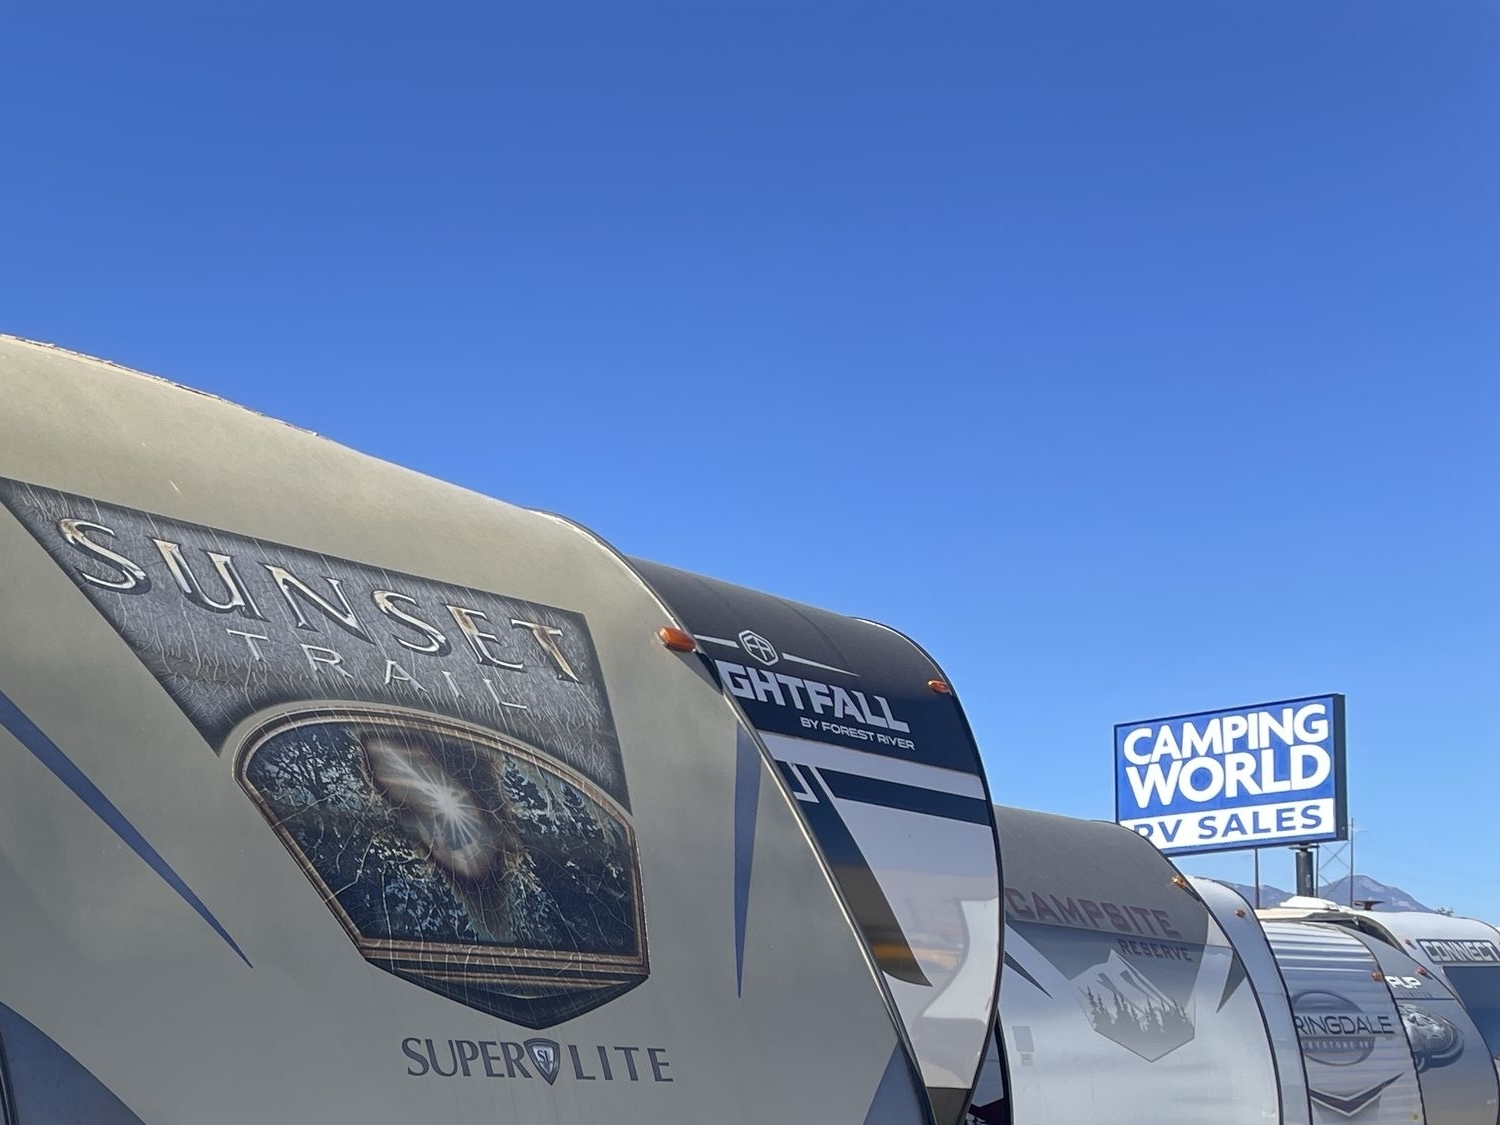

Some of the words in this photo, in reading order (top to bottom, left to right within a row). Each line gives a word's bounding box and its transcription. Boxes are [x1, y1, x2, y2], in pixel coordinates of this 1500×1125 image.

[57, 515, 584, 684] SUNSET
[225, 628, 528, 710] TRAIL
[714, 659, 910, 734] GHTFALL
[799, 716, 819, 732] BY
[821, 721, 875, 744] FOREST
[877, 732, 916, 751] RIVER
[1123, 703, 1329, 766] CAMPING
[1125, 744, 1331, 809] WORLD
[1198, 803, 1323, 840] SALES
[1004, 886, 1182, 940] CAMPSITE
[1116, 937, 1194, 963] RESERVE
[1419, 940, 1500, 962] CONNECT
[1295, 1015, 1395, 1035] RINGDALE
[401, 1036, 533, 1079] SUPER
[568, 1043, 674, 1083] LITE
